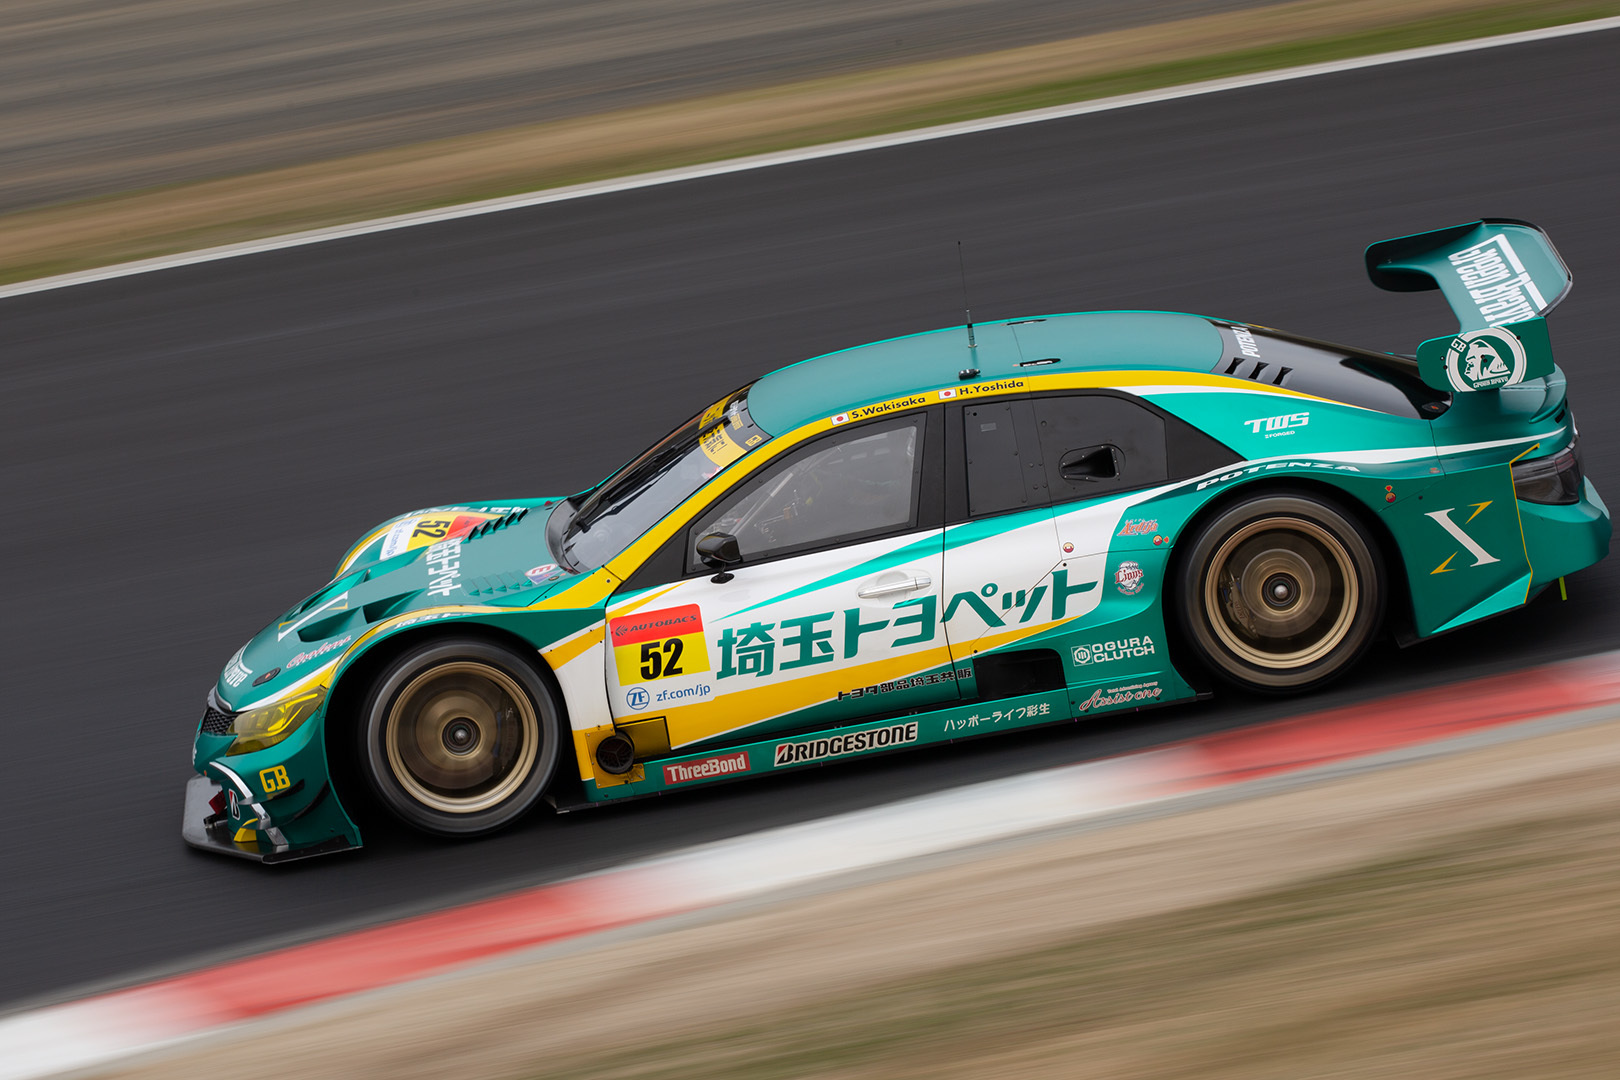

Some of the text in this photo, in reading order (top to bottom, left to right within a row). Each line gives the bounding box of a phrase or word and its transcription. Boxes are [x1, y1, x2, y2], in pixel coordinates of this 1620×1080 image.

[959, 380, 1024, 396] H.Yoshida
[851, 396, 926, 419] S.Wakisaka
[1244, 412, 1310, 433] TWS
[1196, 461, 1361, 492] POTENZA
[412, 520, 452, 539] 52
[629, 614, 698, 633] AUTOBACS
[716, 569, 1098, 681] 埼玉トヨペット
[1092, 635, 1153, 652] OGURA
[1093, 645, 1156, 663] CLUTCH
[640, 638, 684, 681] 52
[627, 688, 649, 709] ZF
[656, 683, 711, 702] zf.com/jp
[774, 722, 918, 767] BRIDGESTONE
[259, 764, 292, 794] GB
[666, 754, 747, 783] ThreeBond
